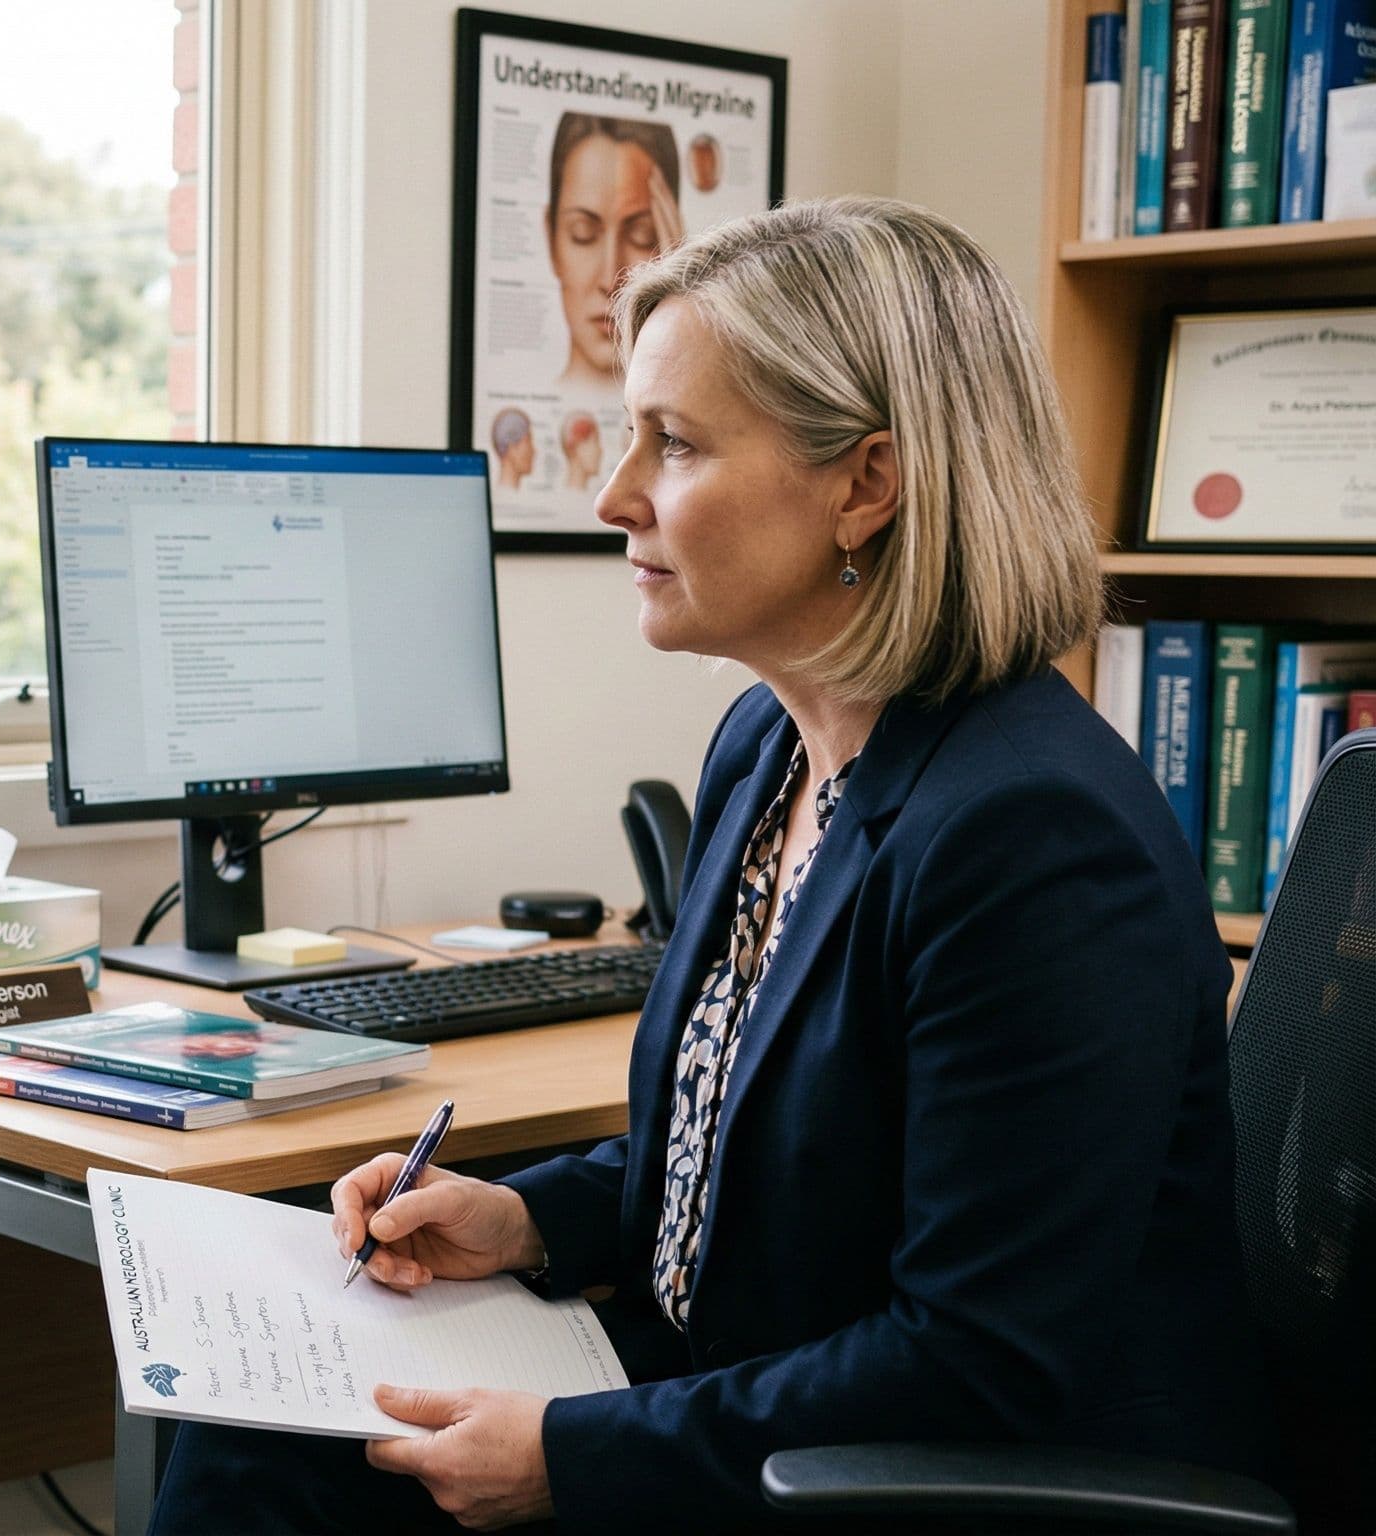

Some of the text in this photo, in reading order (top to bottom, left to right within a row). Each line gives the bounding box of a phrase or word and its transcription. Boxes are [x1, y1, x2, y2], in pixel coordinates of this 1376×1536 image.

[494, 55, 755, 118] Understanding Migraine
[114, 1219, 139, 1286] NEUROLOGY
[127, 1286, 150, 1353] AUSTRALIAN
